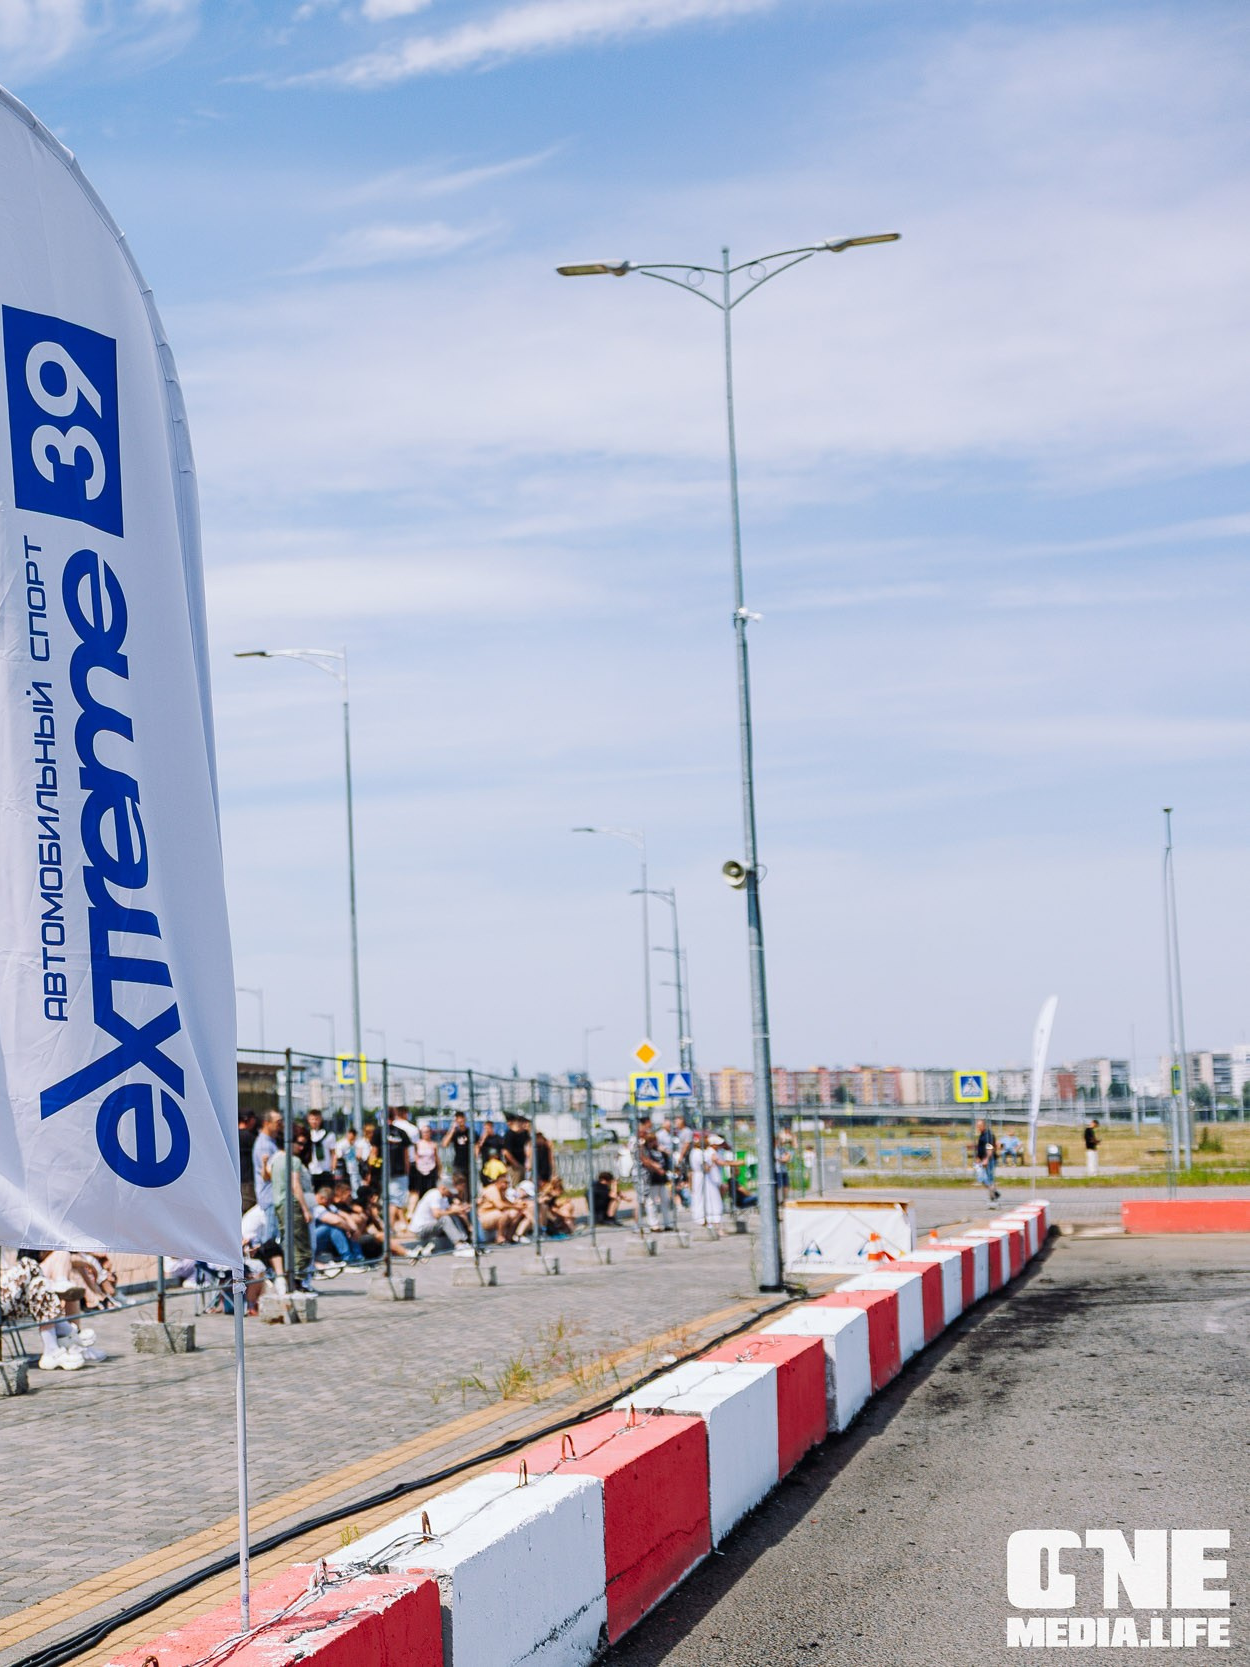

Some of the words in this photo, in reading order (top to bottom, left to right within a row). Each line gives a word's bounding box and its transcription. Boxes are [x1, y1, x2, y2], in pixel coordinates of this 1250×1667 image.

[25, 341, 106, 501] 39
[23, 534, 51, 662] СПОРТ
[26, 681, 68, 1022] АВТОМОБИЛЬНЫЙ
